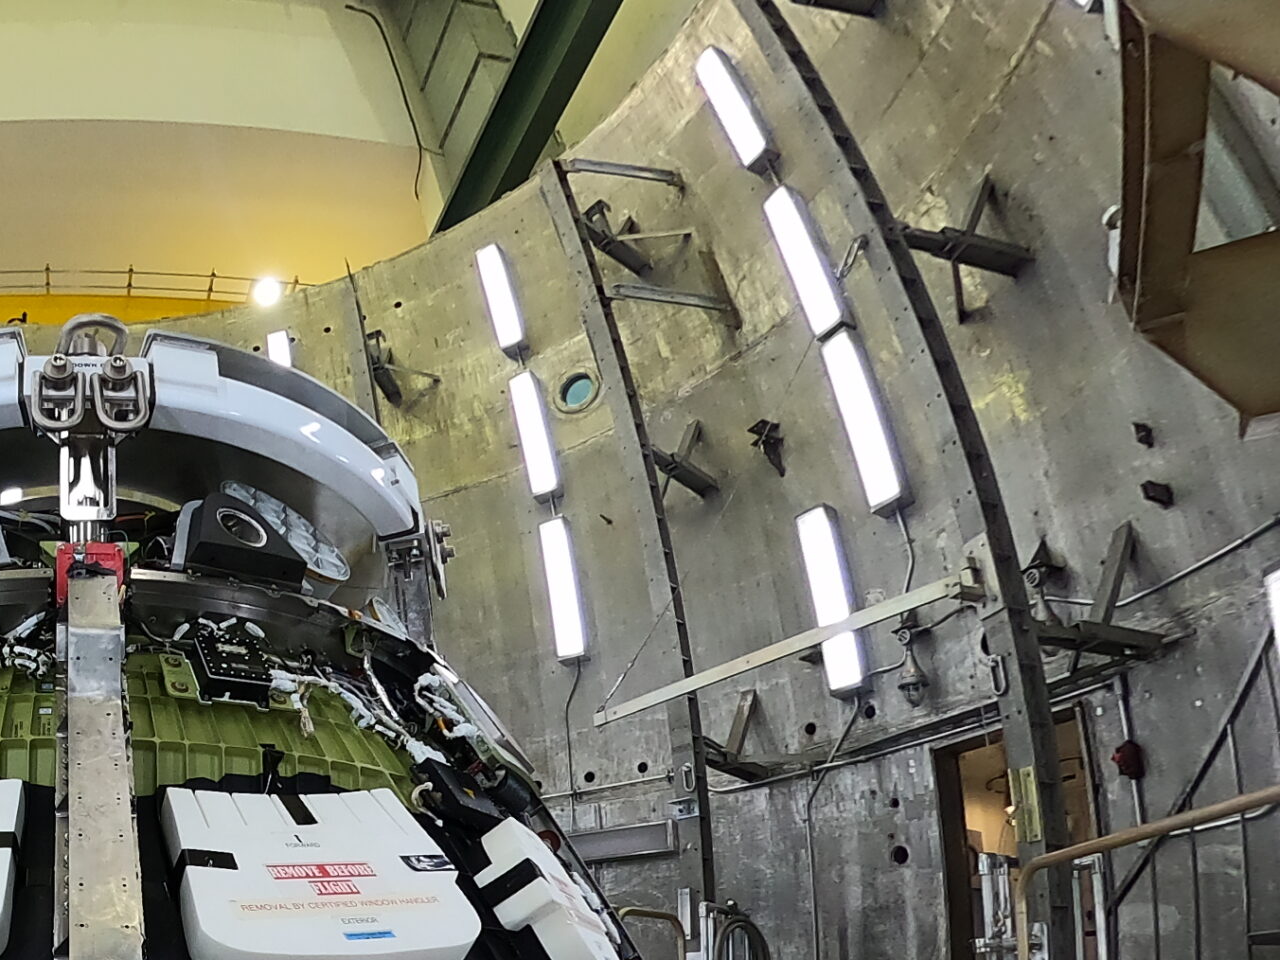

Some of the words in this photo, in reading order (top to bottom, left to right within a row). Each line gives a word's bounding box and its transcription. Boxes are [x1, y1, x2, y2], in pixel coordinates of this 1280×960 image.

[269, 865, 323, 878] REMOVE
[326, 863, 375, 876] BEFORE
[311, 880, 360, 895] FLIGHT
[240, 903, 292, 911] REMOVAL
[292, 902, 305, 910] BY
[307, 900, 357, 909] CERTIFIED
